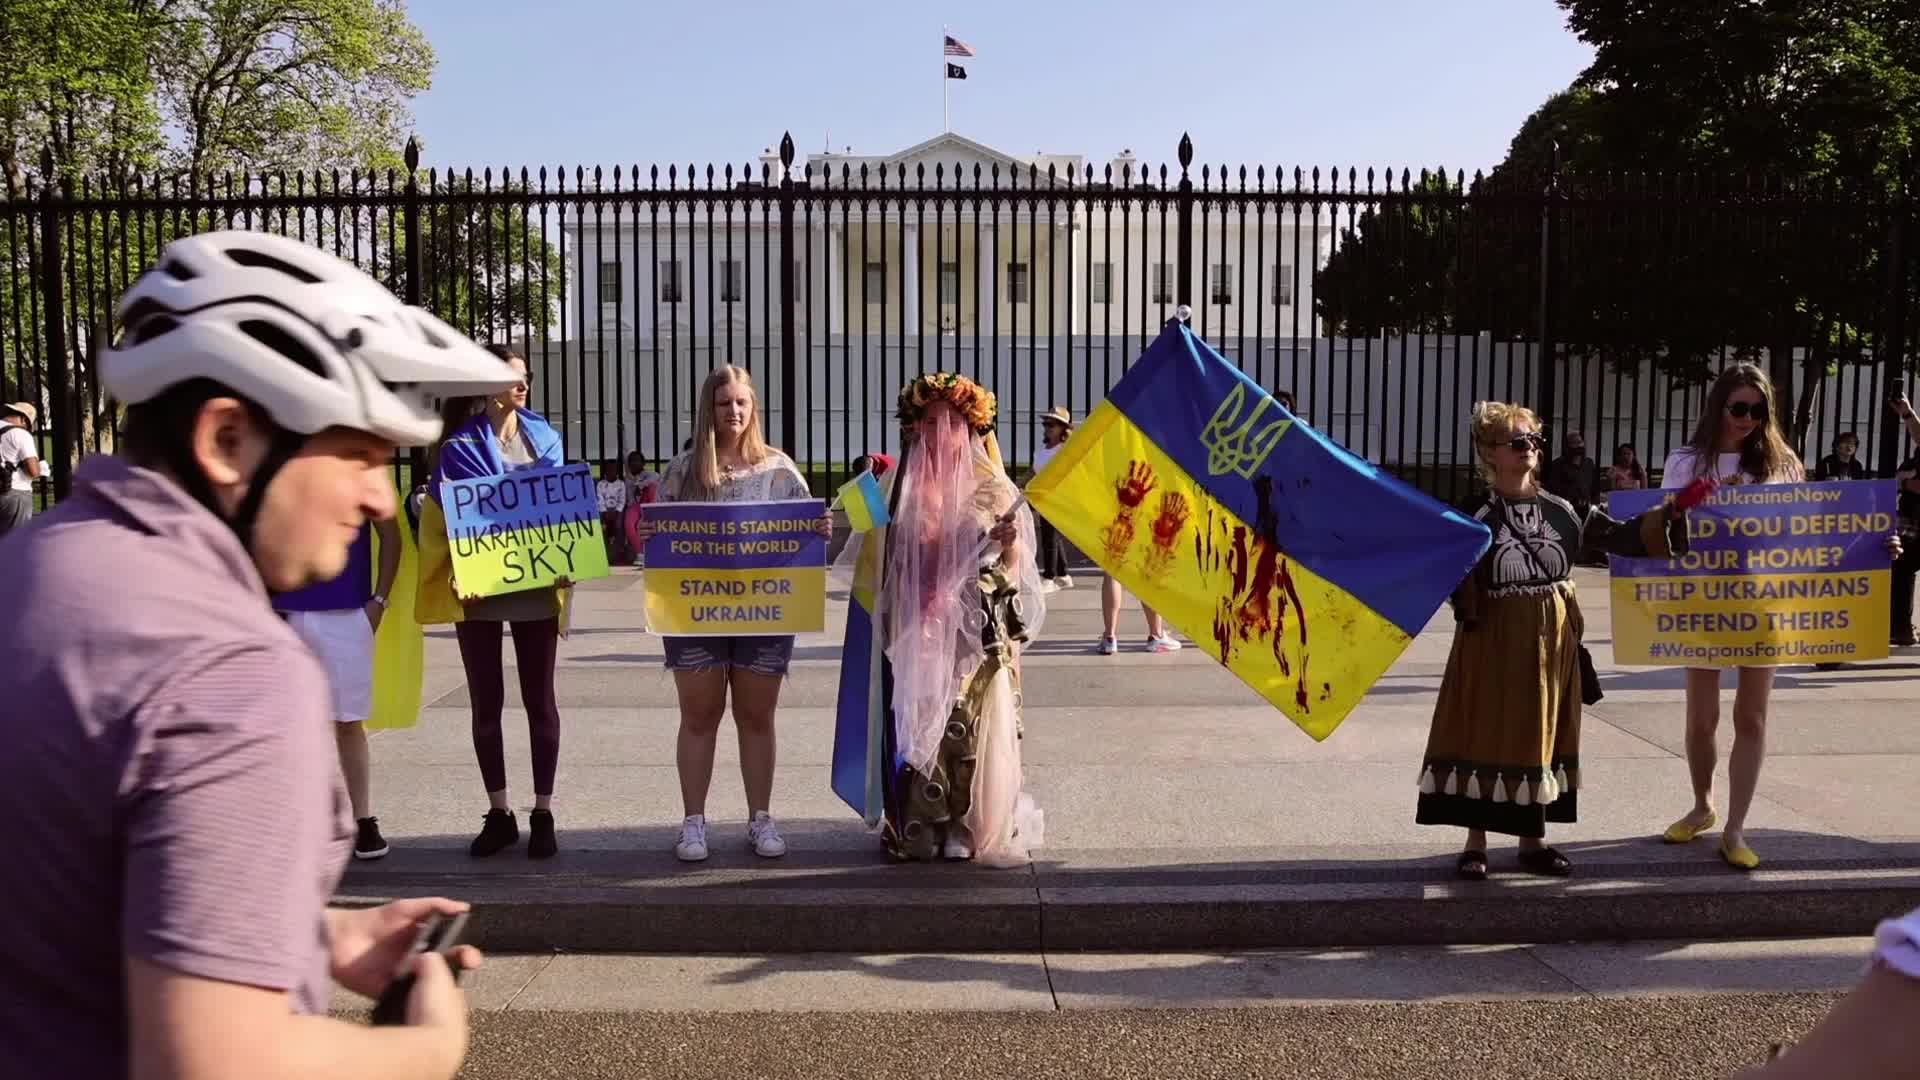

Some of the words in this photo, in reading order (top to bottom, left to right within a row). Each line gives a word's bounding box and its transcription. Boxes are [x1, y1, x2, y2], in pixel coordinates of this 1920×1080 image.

[453, 470, 591, 520] PROTECT
[454, 510, 594, 557] UKRAINIAN
[656, 519, 717, 535] KRAINE
[722, 521, 736, 535] IS
[1724, 517, 1782, 537] YOU
[1791, 513, 1891, 536] DEFEND
[671, 541, 702, 554] FOR
[707, 541, 736, 555] THE
[739, 540, 800, 555] WORLD
[1747, 547, 1843, 568] HOME?
[502, 541, 575, 583] SKY
[680, 580, 746, 596] STAND
[752, 579, 791, 595] FOR
[1635, 582, 1696, 601] HELP
[1703, 576, 1869, 600] UKRAINIANS
[691, 605, 782, 621] UKRAINE
[1657, 613, 1757, 632] DEFEND
[1765, 610, 1849, 631] THEIRS
[1649, 639, 1856, 662] #WeaponsForUkraine
